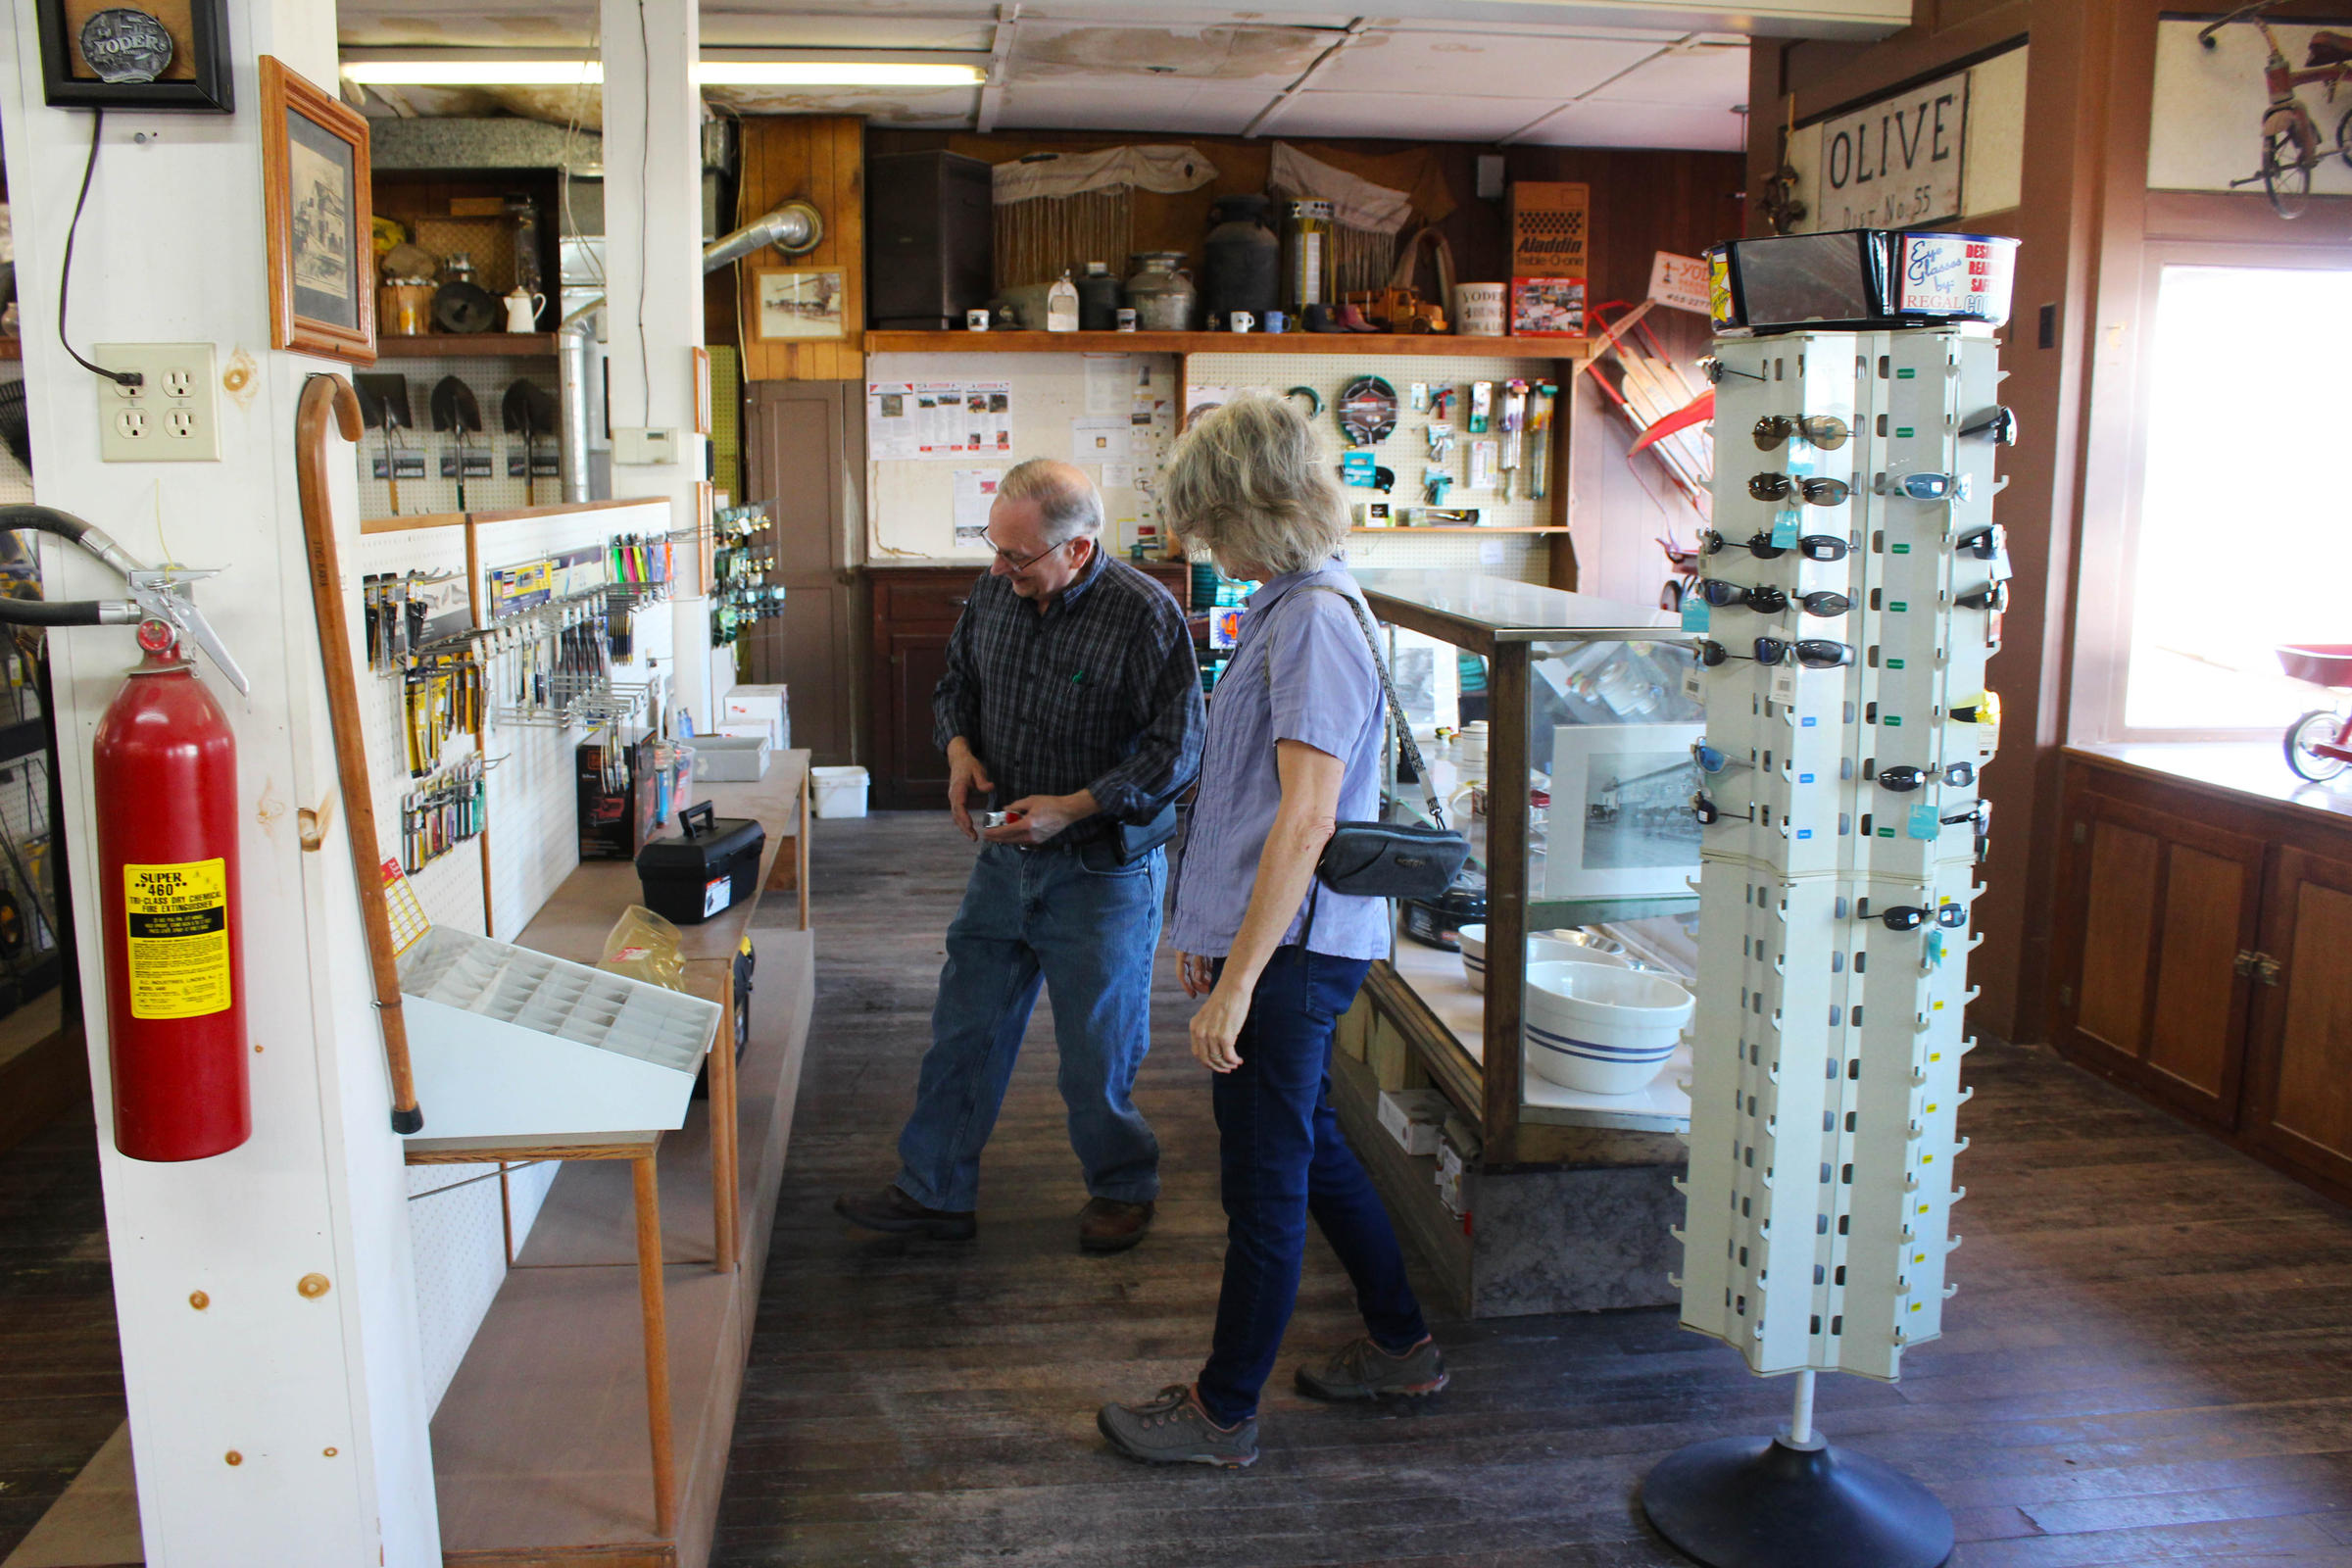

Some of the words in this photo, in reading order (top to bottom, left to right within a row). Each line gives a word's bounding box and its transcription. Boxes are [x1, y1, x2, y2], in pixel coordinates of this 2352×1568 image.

[1829, 93, 1953, 189] OLIVE
[1913, 185, 1932, 216] 55
[1517, 236, 1584, 253] Aladdin
[1910, 240, 1943, 263] Eye
[1907, 257, 1962, 286] Glasses
[1906, 294, 1962, 309] REGAL
[140, 871, 182, 883] SUPER
[148, 883, 174, 896] 460
[129, 896, 169, 906] TRI-CLASS
[188, 891, 221, 903] CHEMICAL
[142, 905, 159, 913] FIRE
[162, 900, 213, 913] EXTINGUISHER
